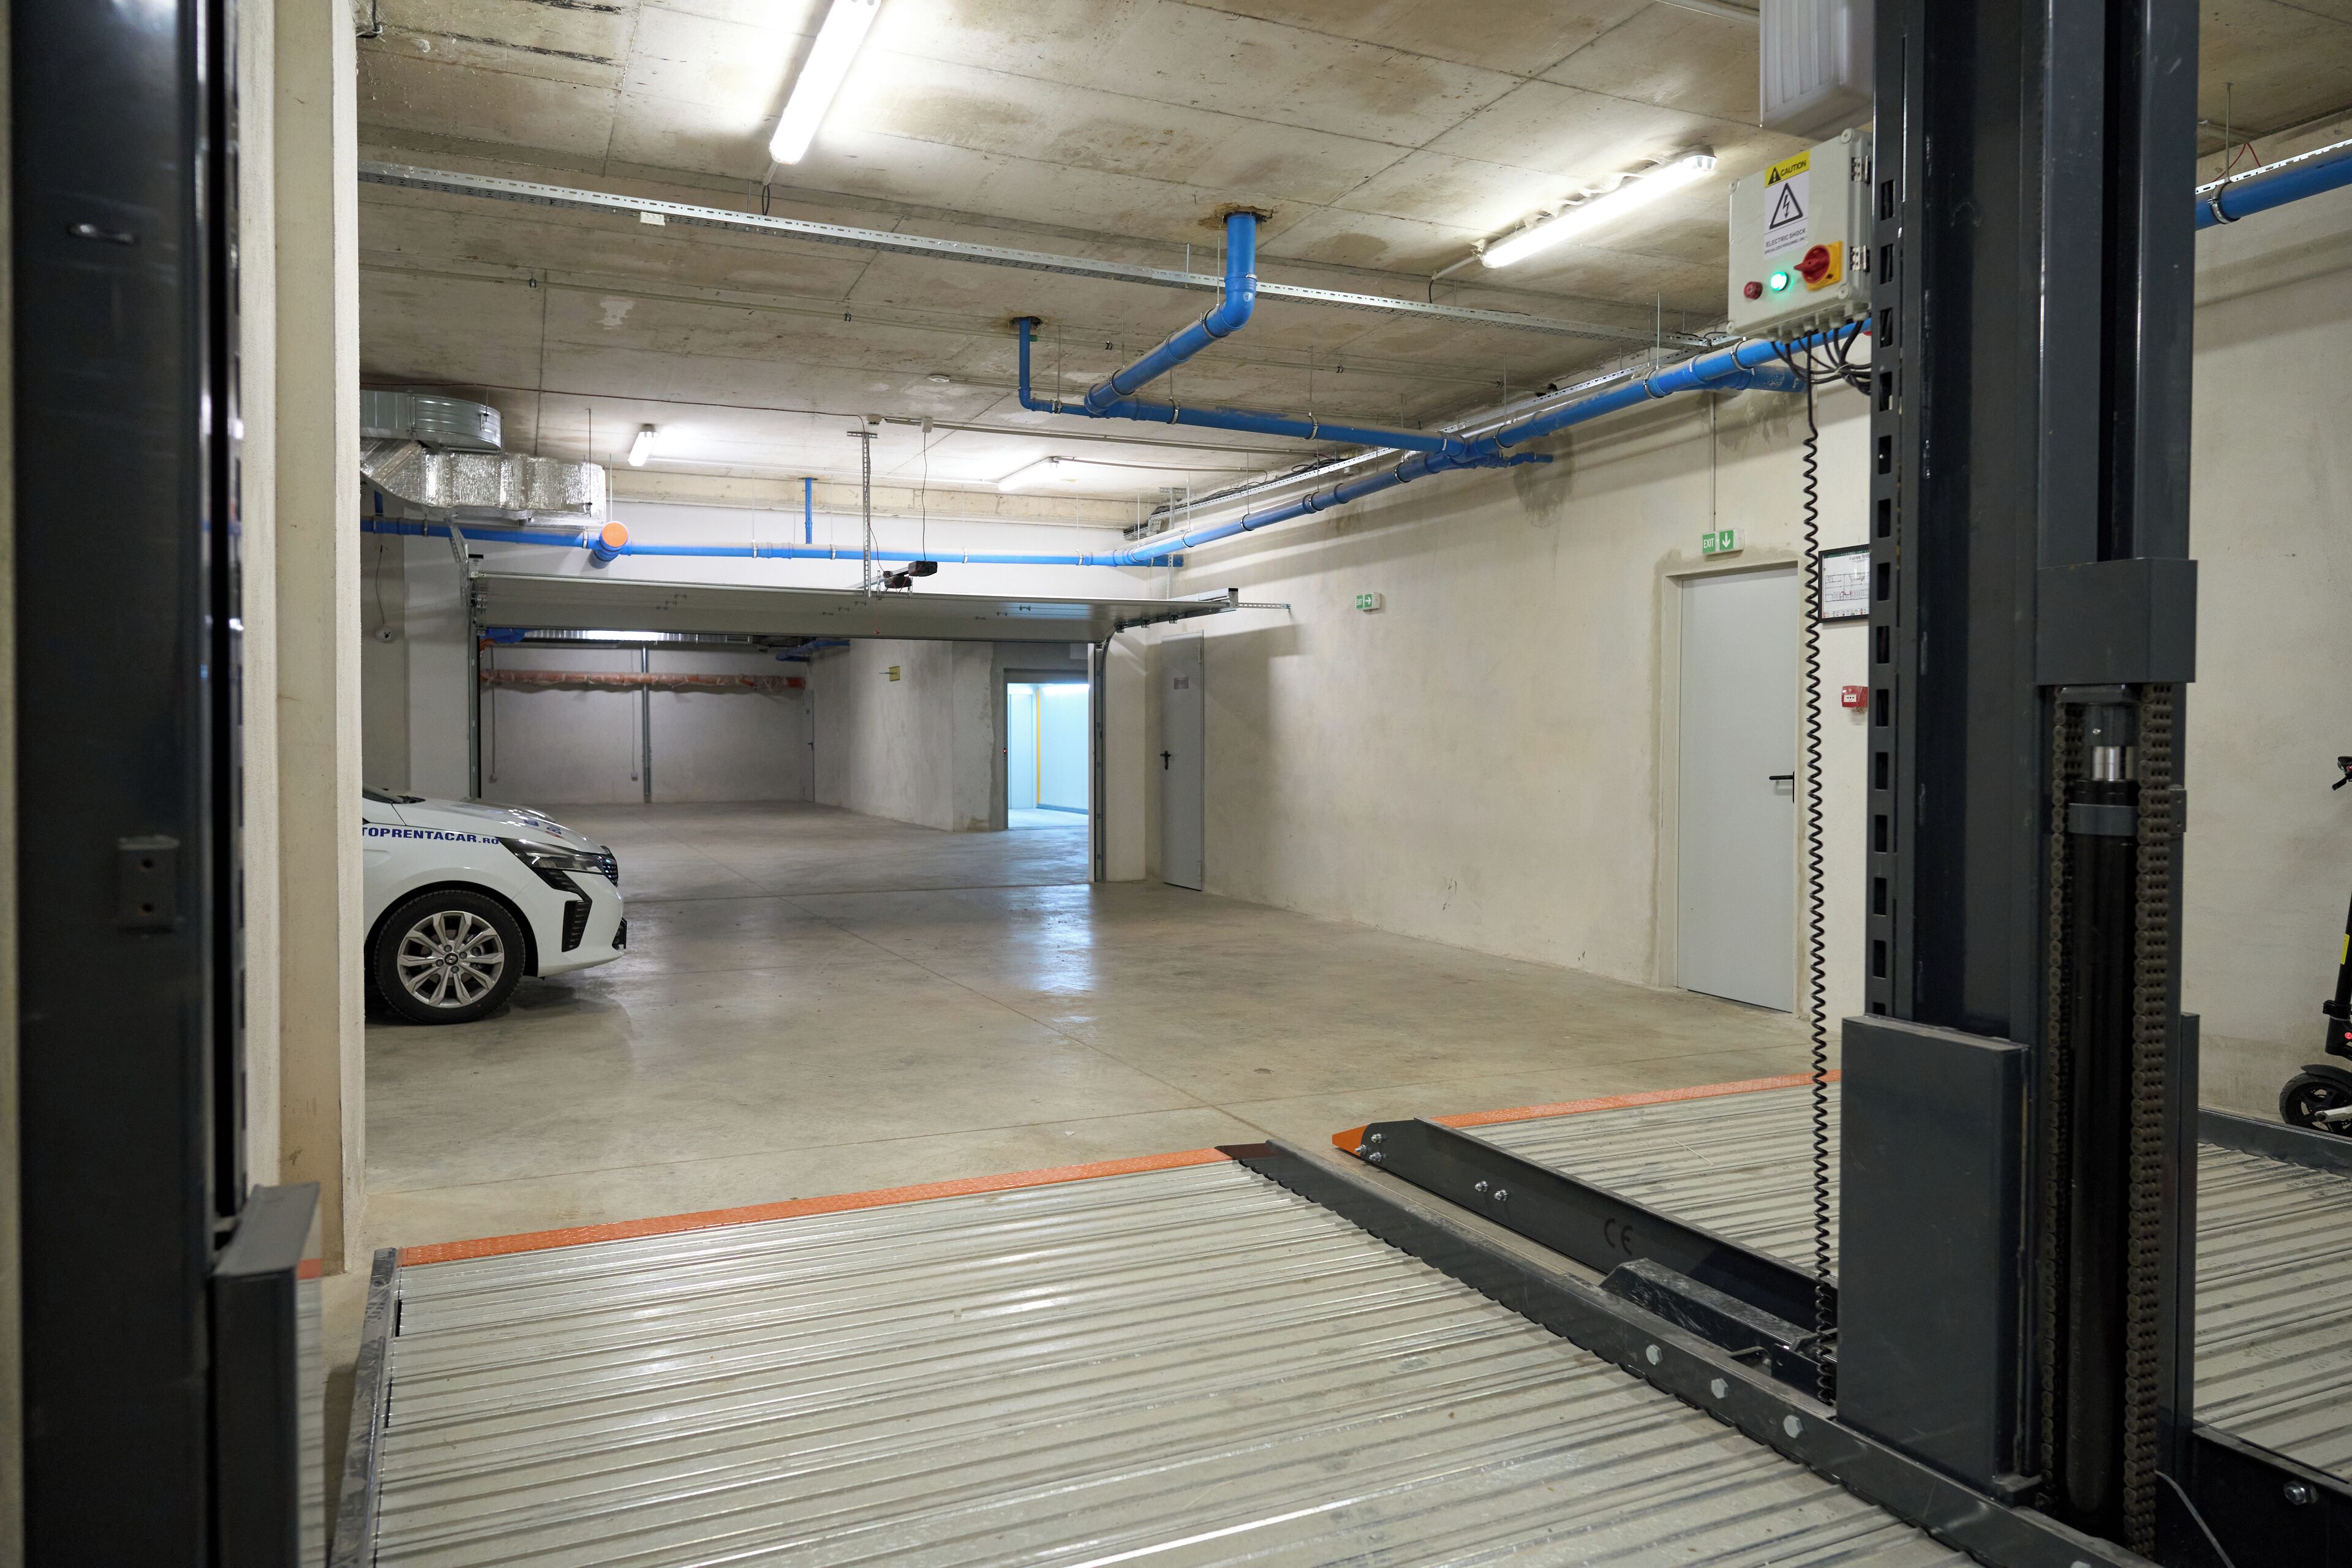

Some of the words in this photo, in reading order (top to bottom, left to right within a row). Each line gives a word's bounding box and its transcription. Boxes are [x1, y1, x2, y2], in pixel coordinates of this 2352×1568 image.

[1781, 160, 1807, 176] CAUTION
[1766, 234, 1789, 247] ELECTRIC
[1790, 228, 1806, 239] SHOCK
[1703, 538, 1714, 548] EXIT
